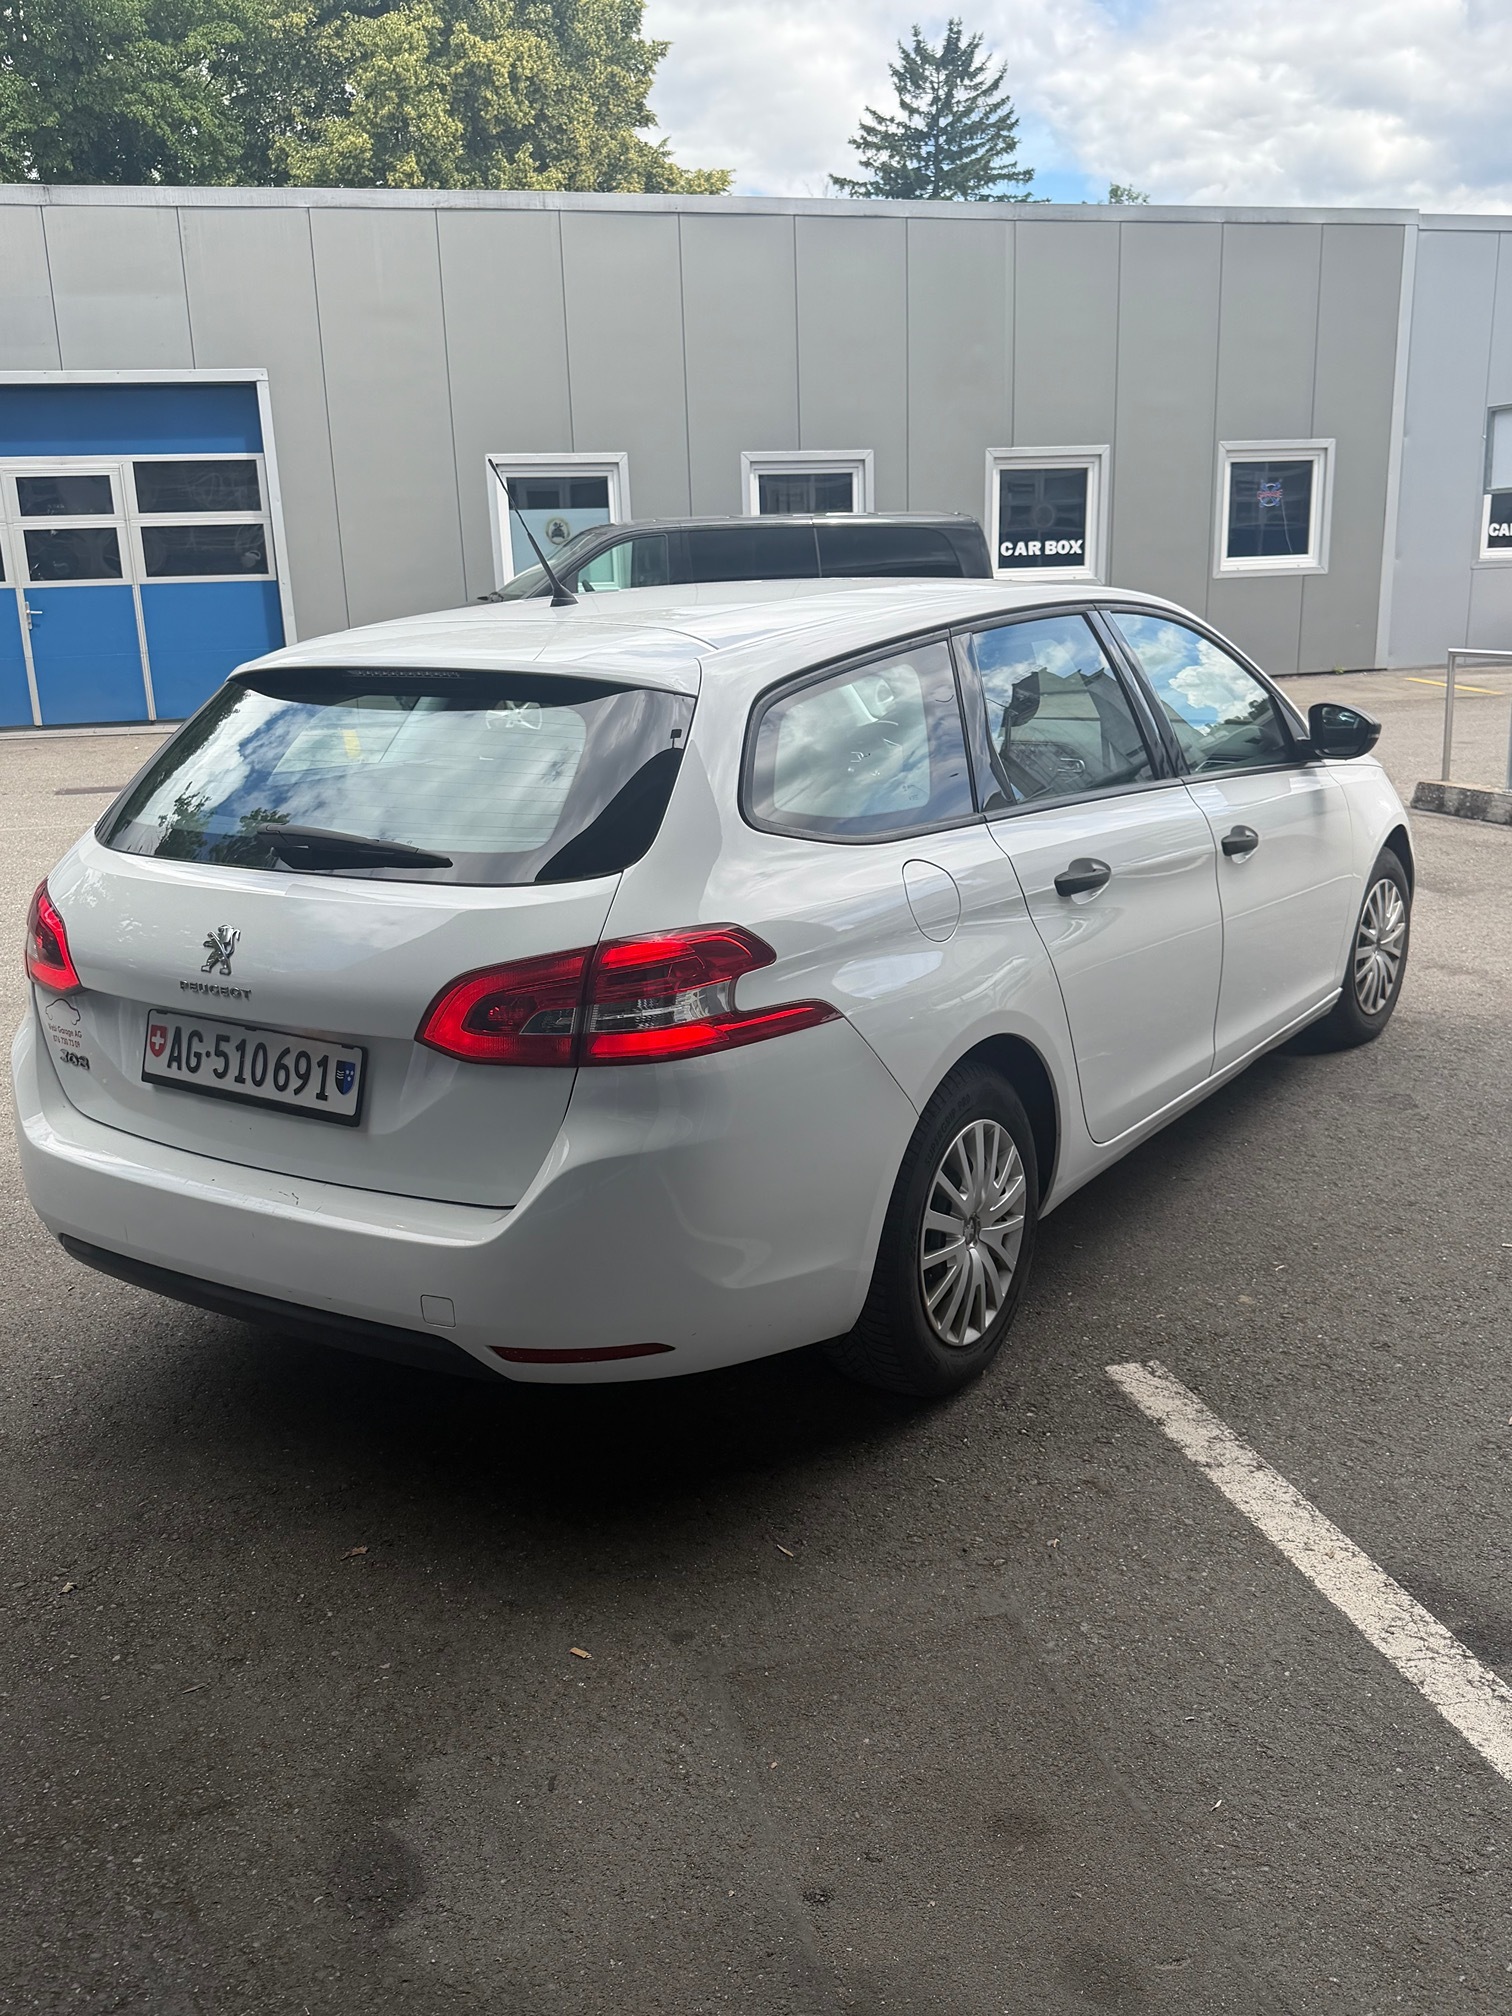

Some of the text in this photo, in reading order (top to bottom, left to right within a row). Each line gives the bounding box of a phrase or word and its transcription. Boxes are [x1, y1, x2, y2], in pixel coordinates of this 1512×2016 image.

[1488, 522, 1512, 537] CA
[1000, 539, 1083, 557] CAR BOX
[180, 980, 252, 1001] PEUGEOT
[57, 1026, 74, 1037] Garage
[74, 1030, 83, 1039] AG
